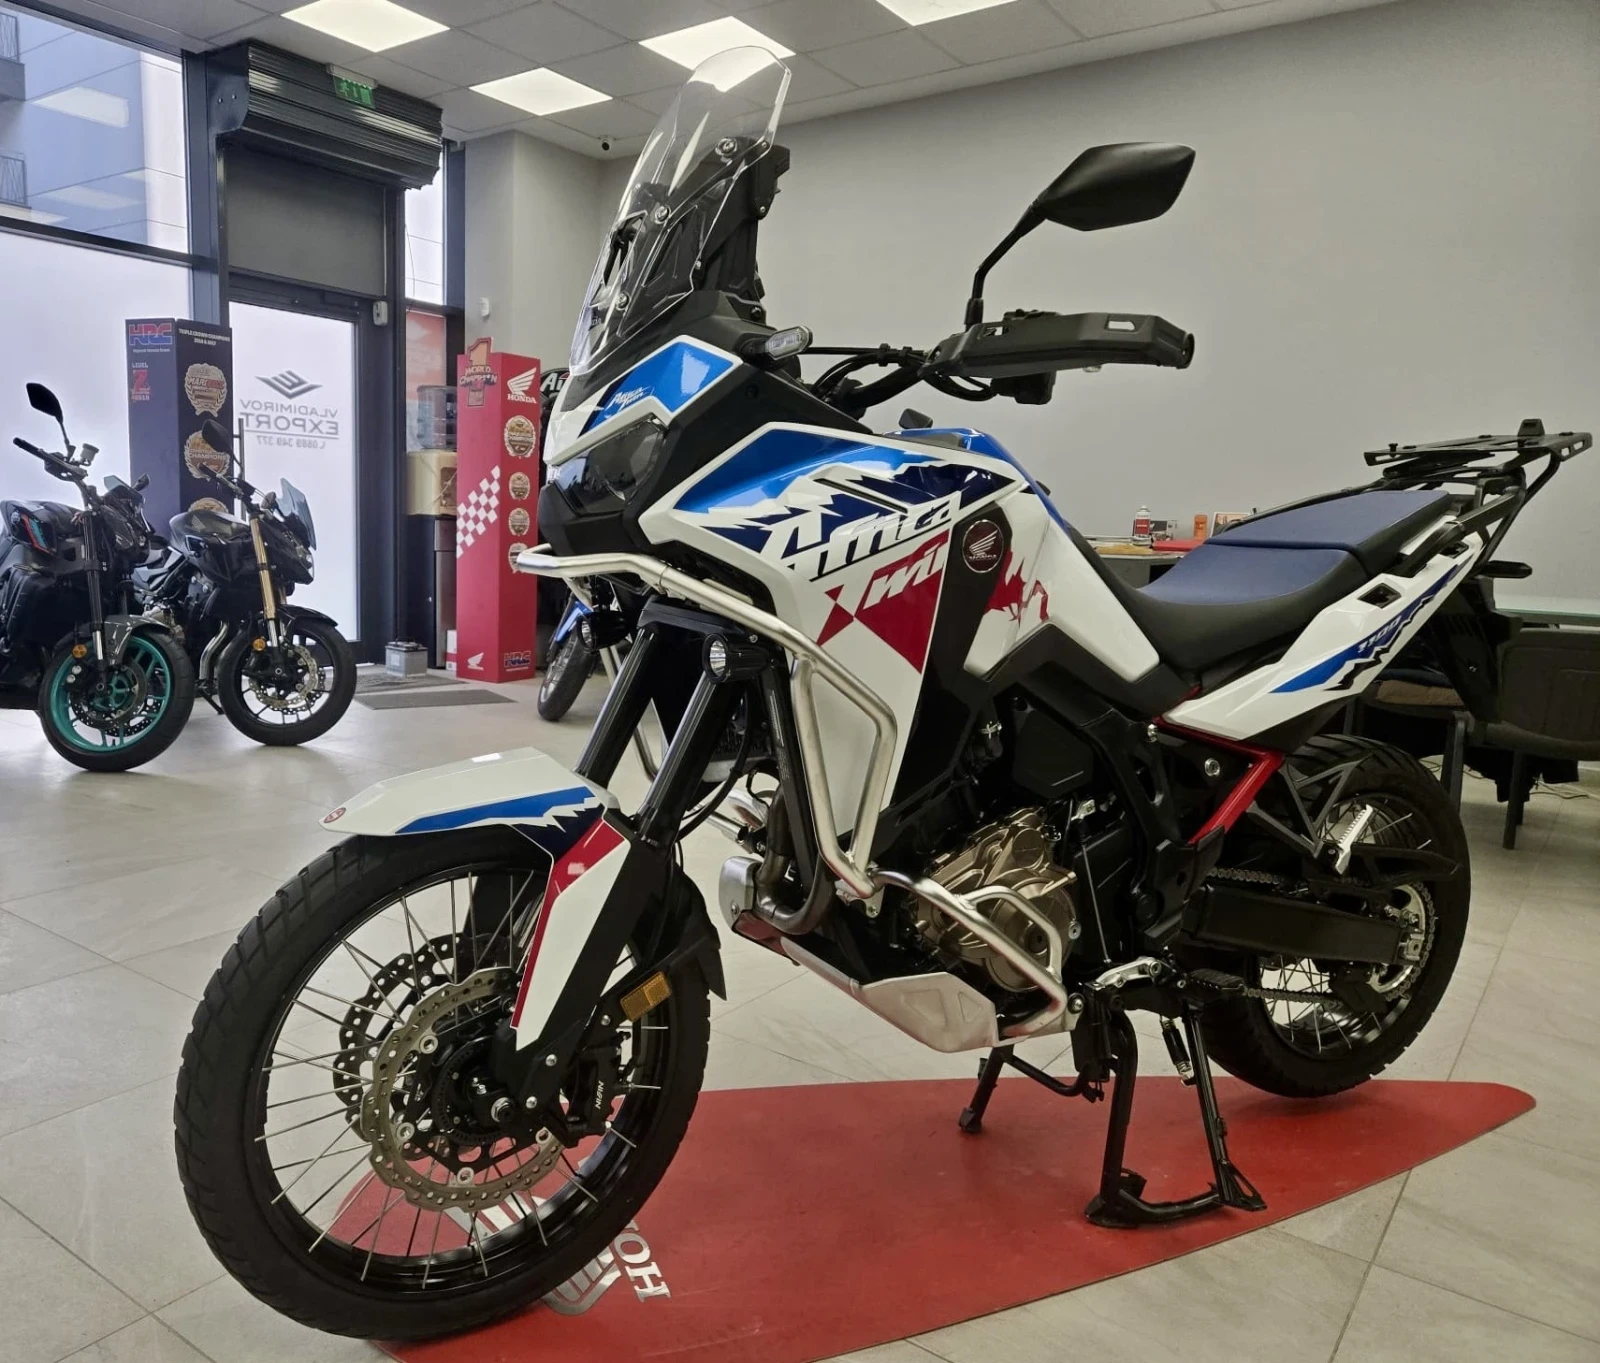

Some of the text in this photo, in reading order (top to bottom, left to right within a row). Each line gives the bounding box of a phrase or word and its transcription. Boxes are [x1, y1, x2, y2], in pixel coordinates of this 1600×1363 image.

[129, 323, 173, 346] HRC
[507, 394, 537, 404] HONDA
[1357, 614, 1402, 653] 1100
[613, 1219, 671, 1302] HO
